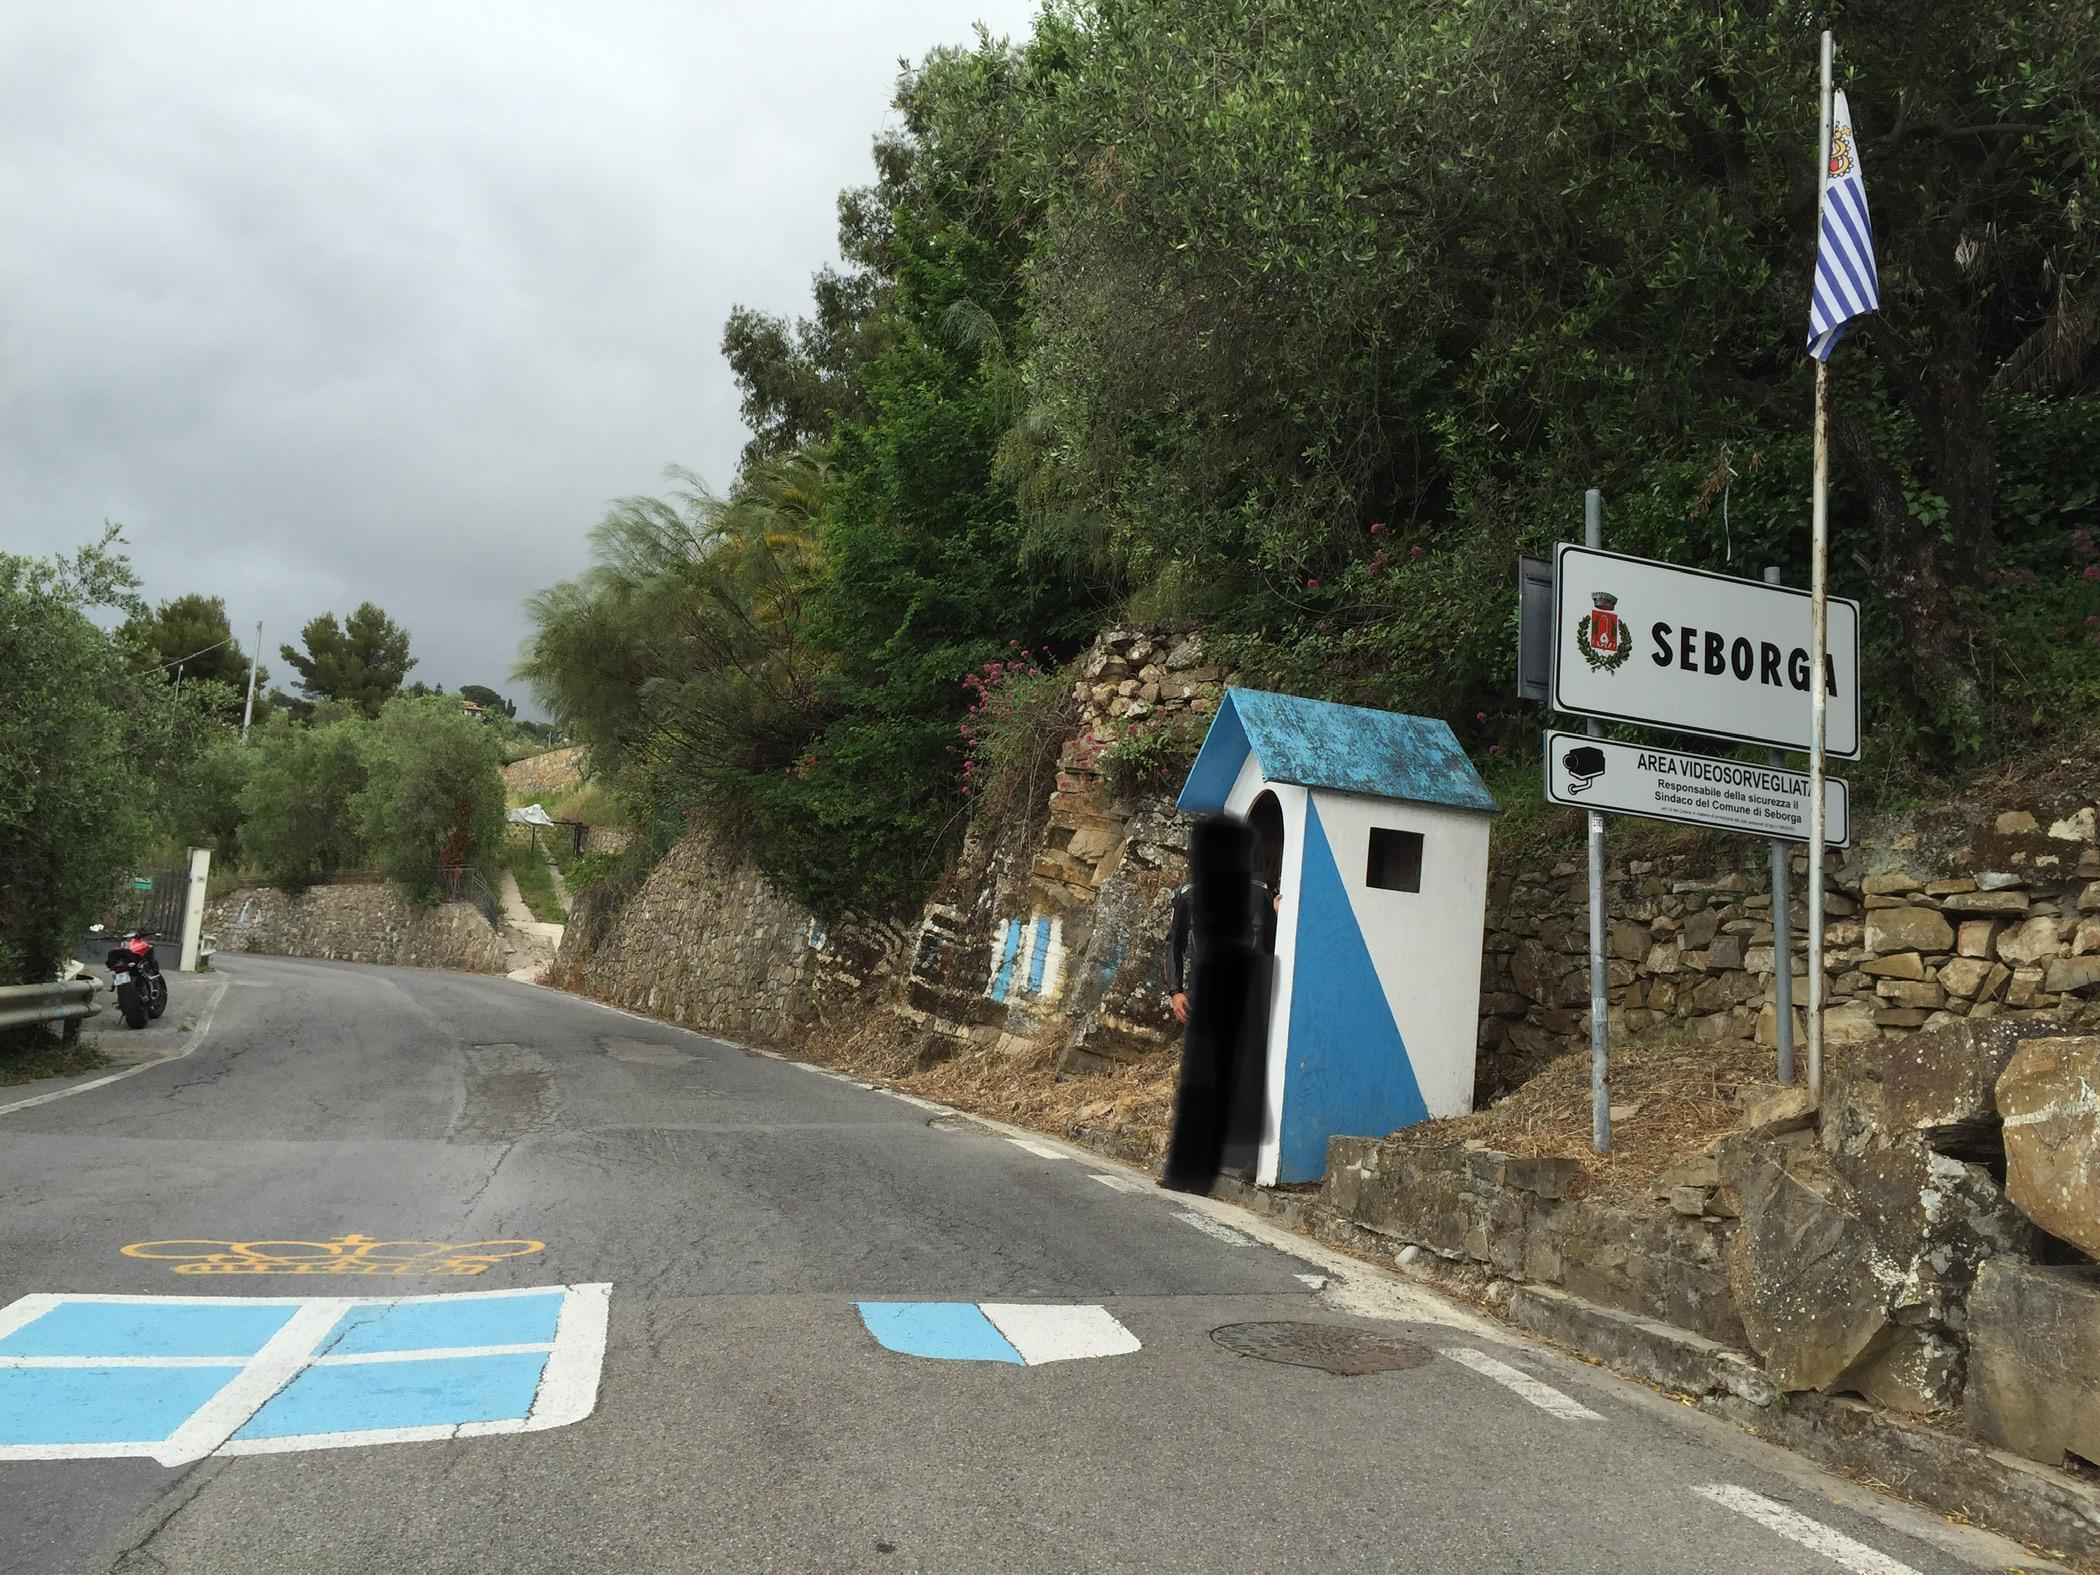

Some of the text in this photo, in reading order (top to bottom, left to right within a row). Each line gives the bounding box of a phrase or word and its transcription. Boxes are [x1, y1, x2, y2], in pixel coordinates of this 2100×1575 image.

[1637, 753, 1811, 797] AREA VIDEOSORVEGLIAT
[1654, 791, 1693, 806] Sindaco
[1695, 797, 1710, 808] del
[1712, 800, 1751, 815] Comune
[1753, 807, 1762, 817] di
[1764, 808, 1802, 824] Seborga
[1658, 778, 1799, 809] Responsabile della sicurezza il
